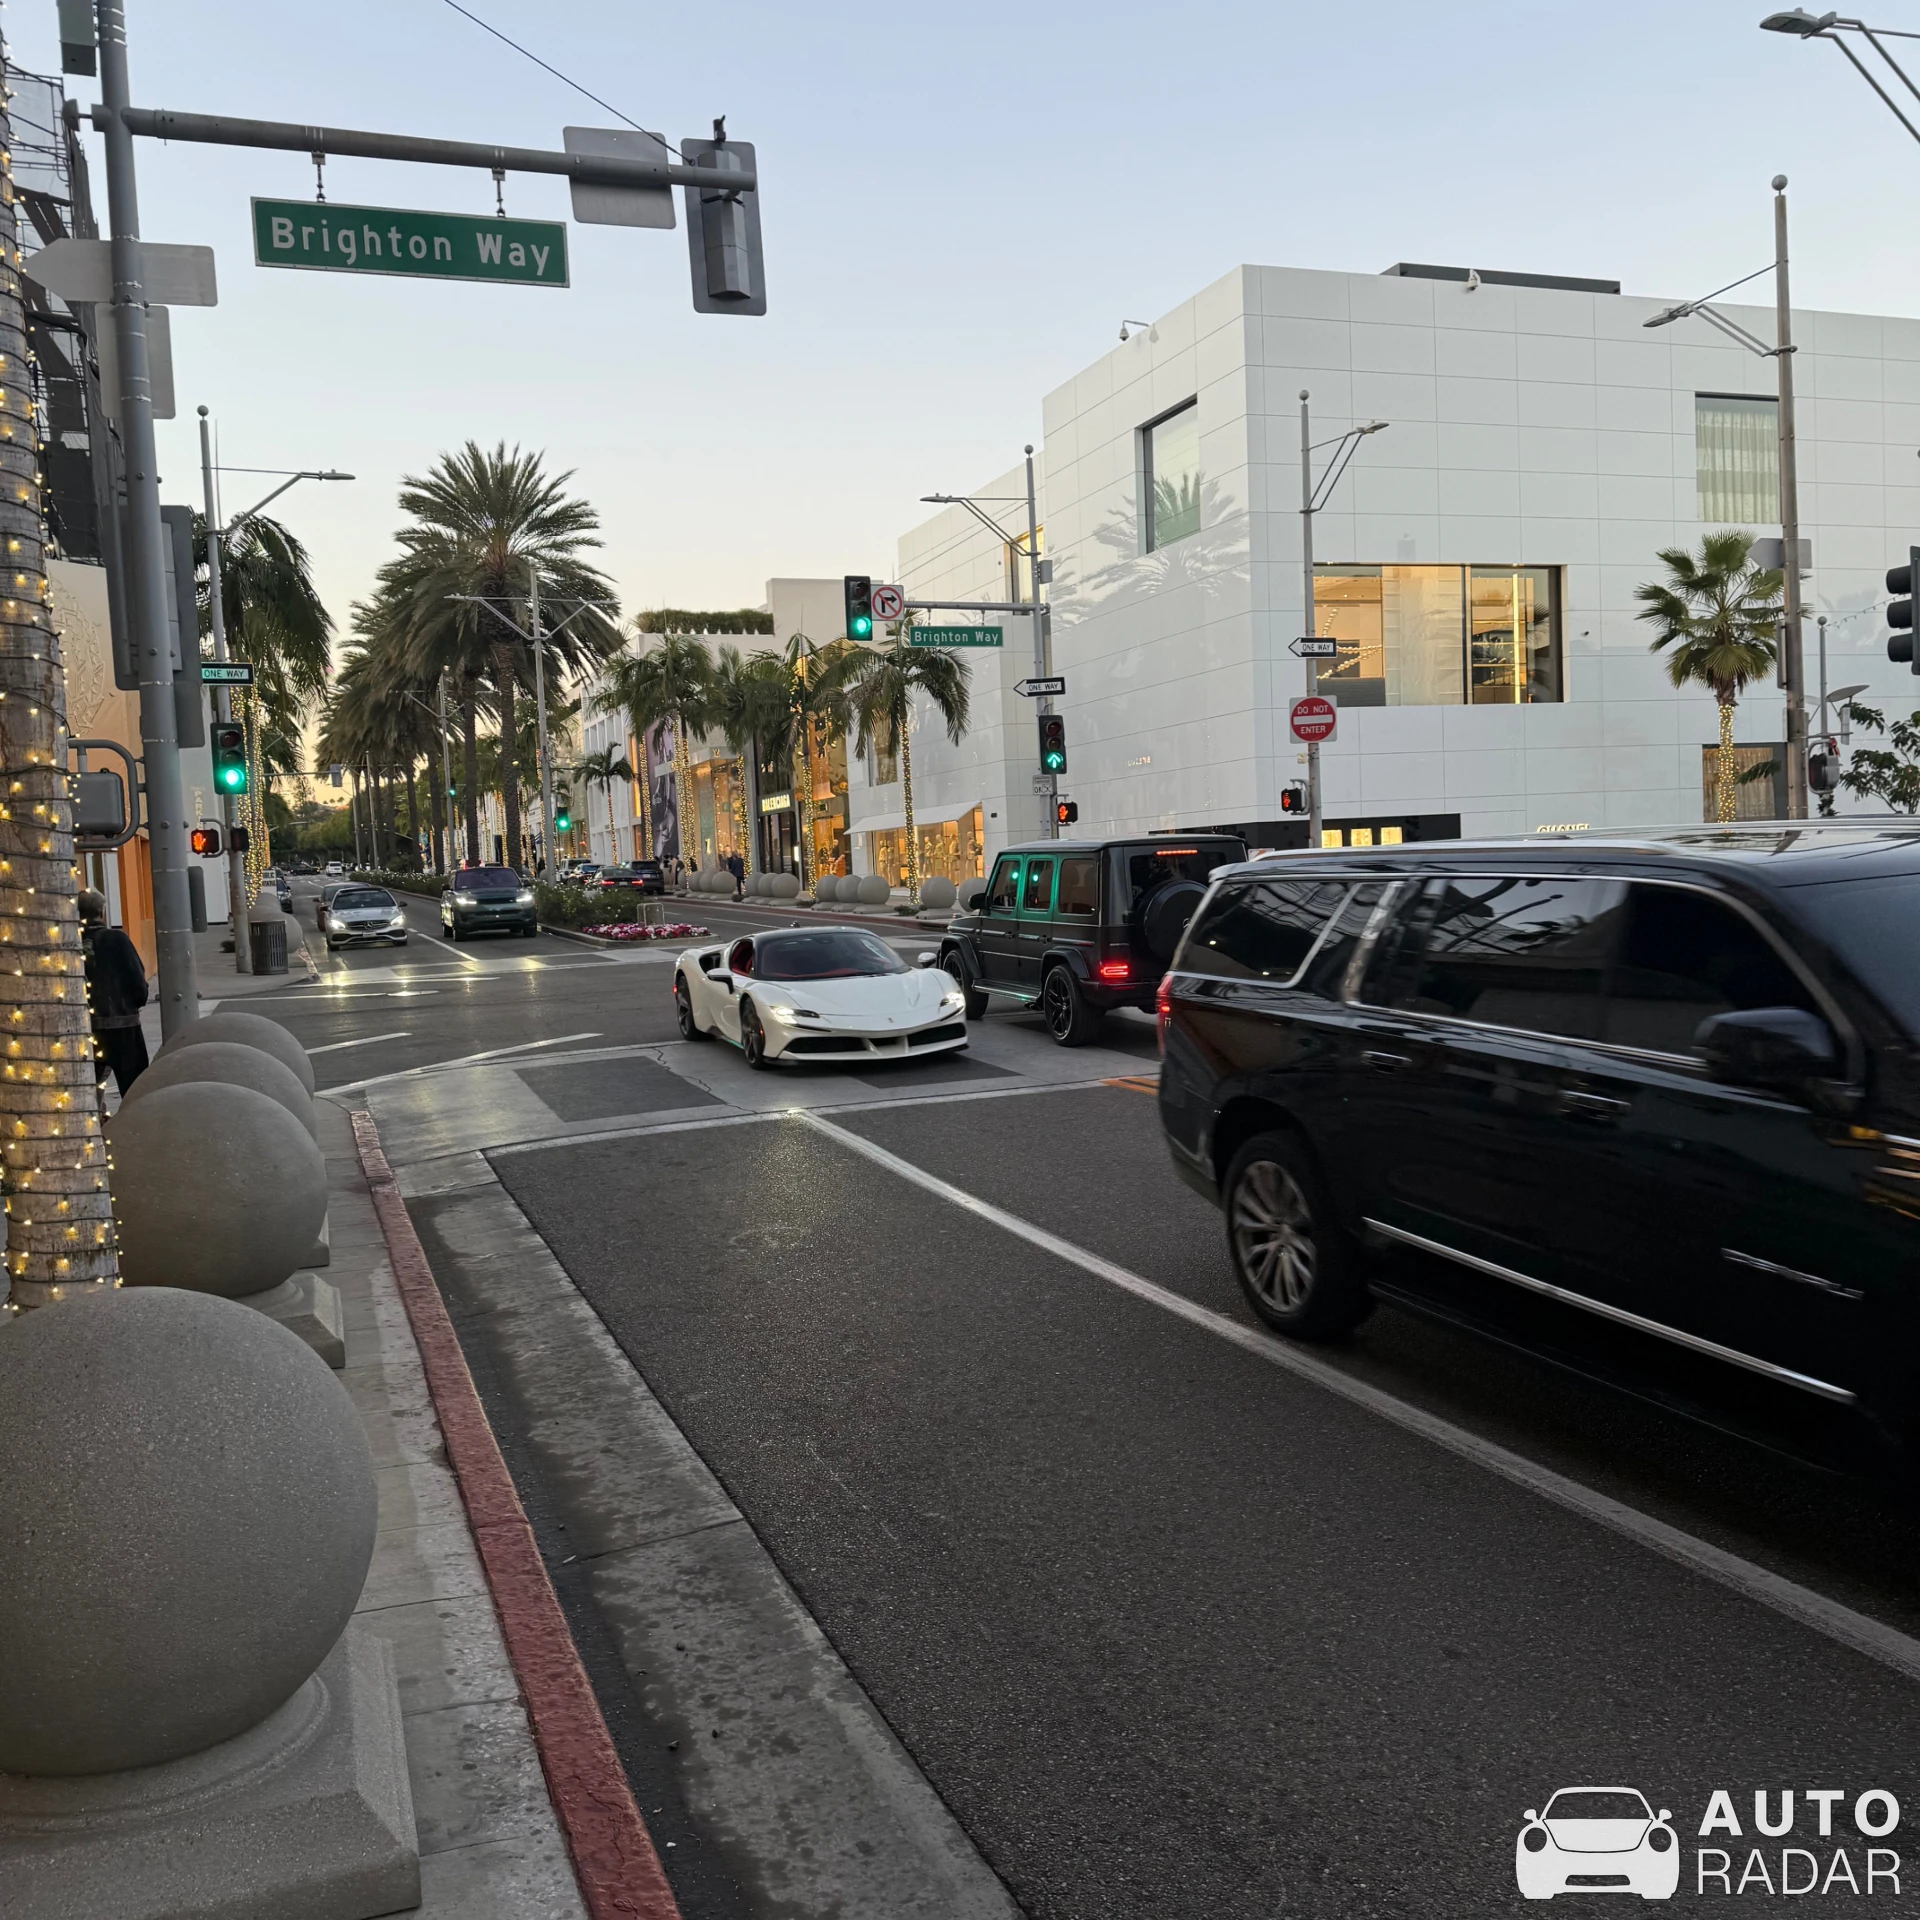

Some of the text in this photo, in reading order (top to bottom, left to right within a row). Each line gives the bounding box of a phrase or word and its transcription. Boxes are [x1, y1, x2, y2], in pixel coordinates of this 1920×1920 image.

[271, 216, 550, 276] Brighton Way
[914, 631, 999, 645] Brighton Way
[1302, 643, 1331, 651] ONE WAY
[203, 669, 244, 678] ONE WAY
[1028, 683, 1043, 692] ONE
[1297, 704, 1329, 714] DO NOT
[1300, 725, 1326, 734] ENTER
